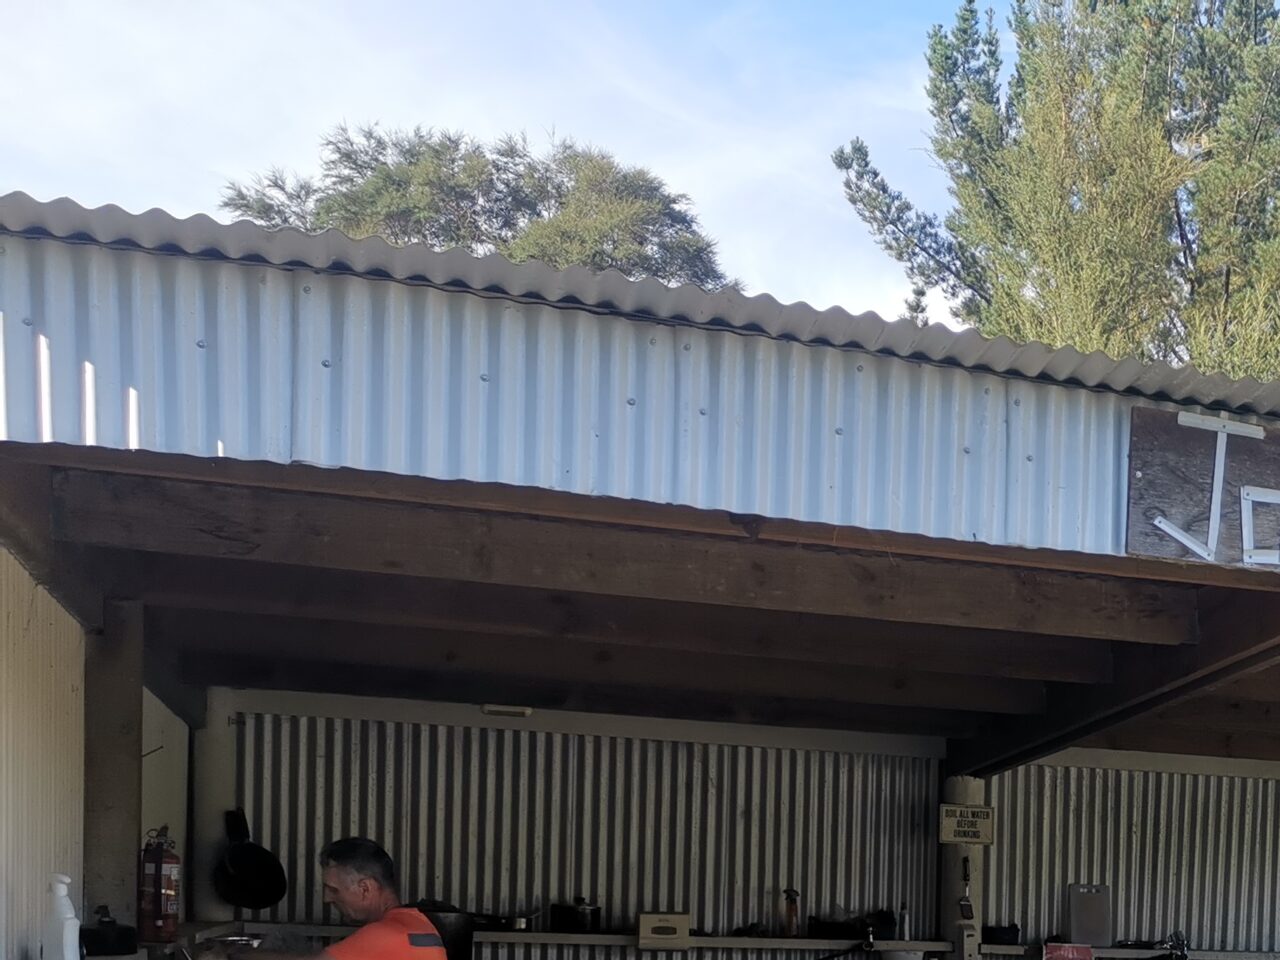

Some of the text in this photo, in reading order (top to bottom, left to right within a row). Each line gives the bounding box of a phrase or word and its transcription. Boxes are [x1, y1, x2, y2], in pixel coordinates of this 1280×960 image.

[959, 809, 969, 819] ALL
[970, 810, 990, 820] WATER
[956, 819, 978, 829] BEFORE
